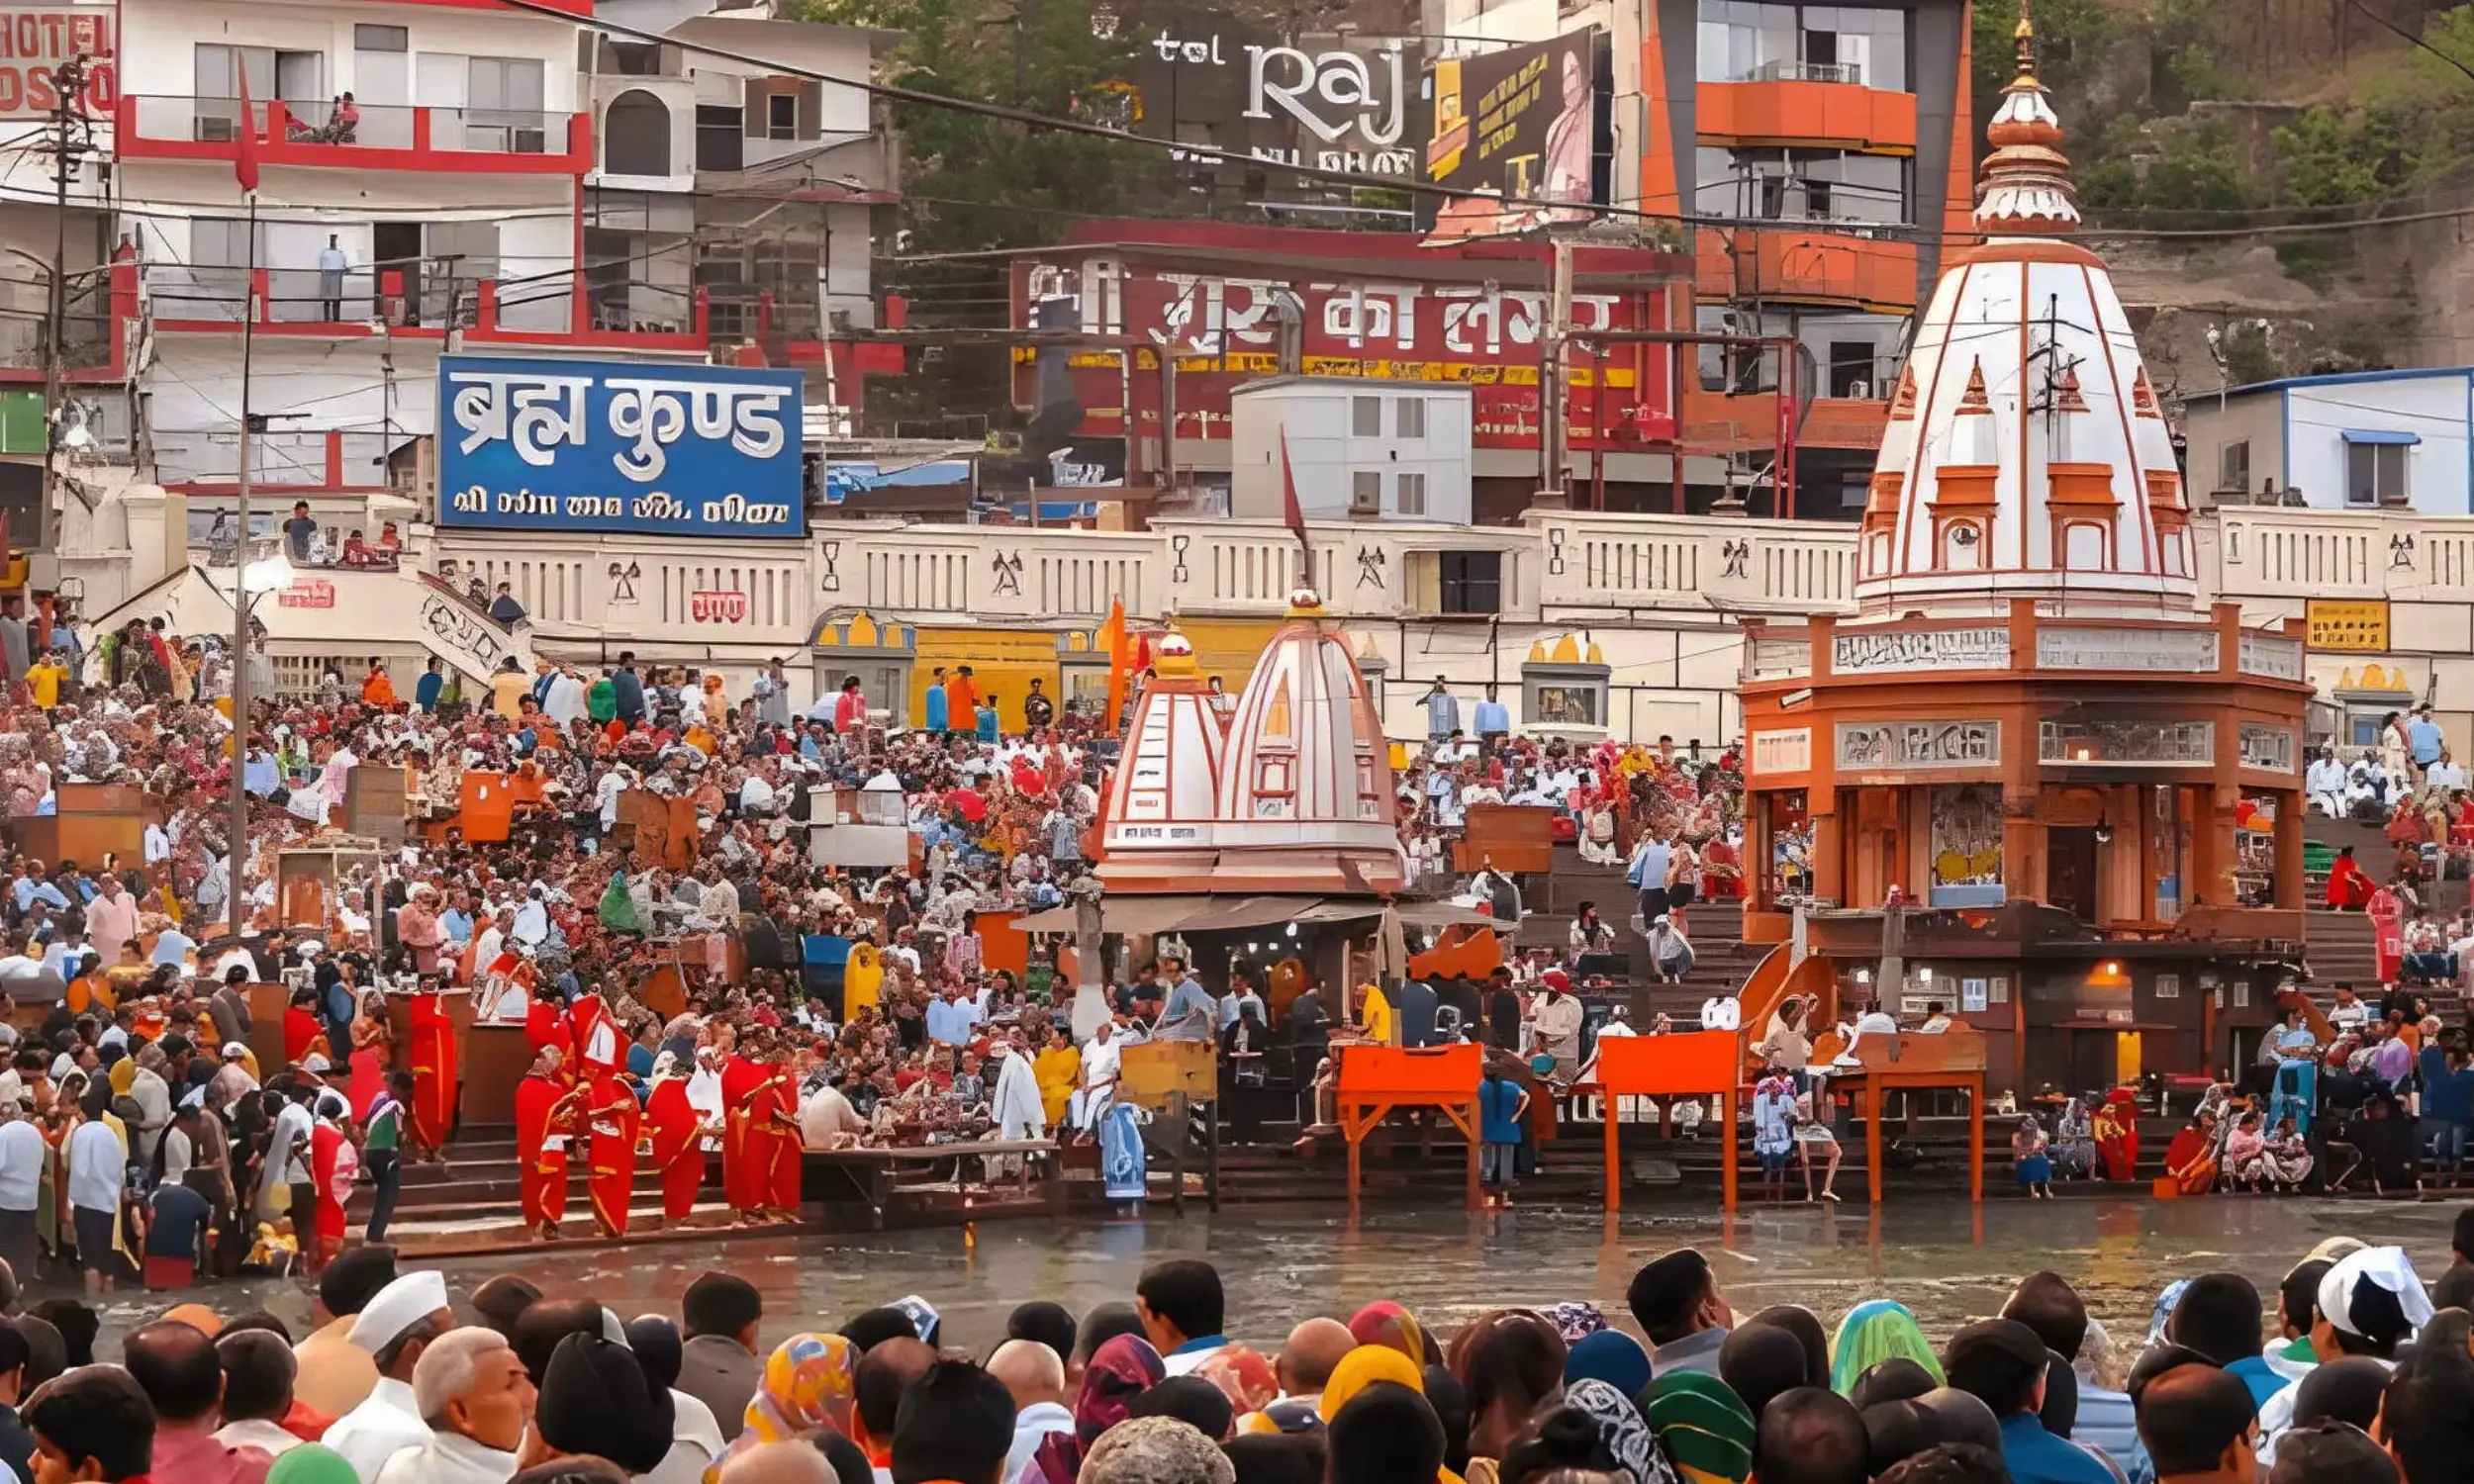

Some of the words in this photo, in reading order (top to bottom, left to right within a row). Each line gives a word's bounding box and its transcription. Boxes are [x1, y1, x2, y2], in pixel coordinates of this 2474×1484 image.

[1310, 283, 1423, 349] का
[449, 372, 593, 466] ब्रह्म
[605, 377, 793, 482] कुण्ड
